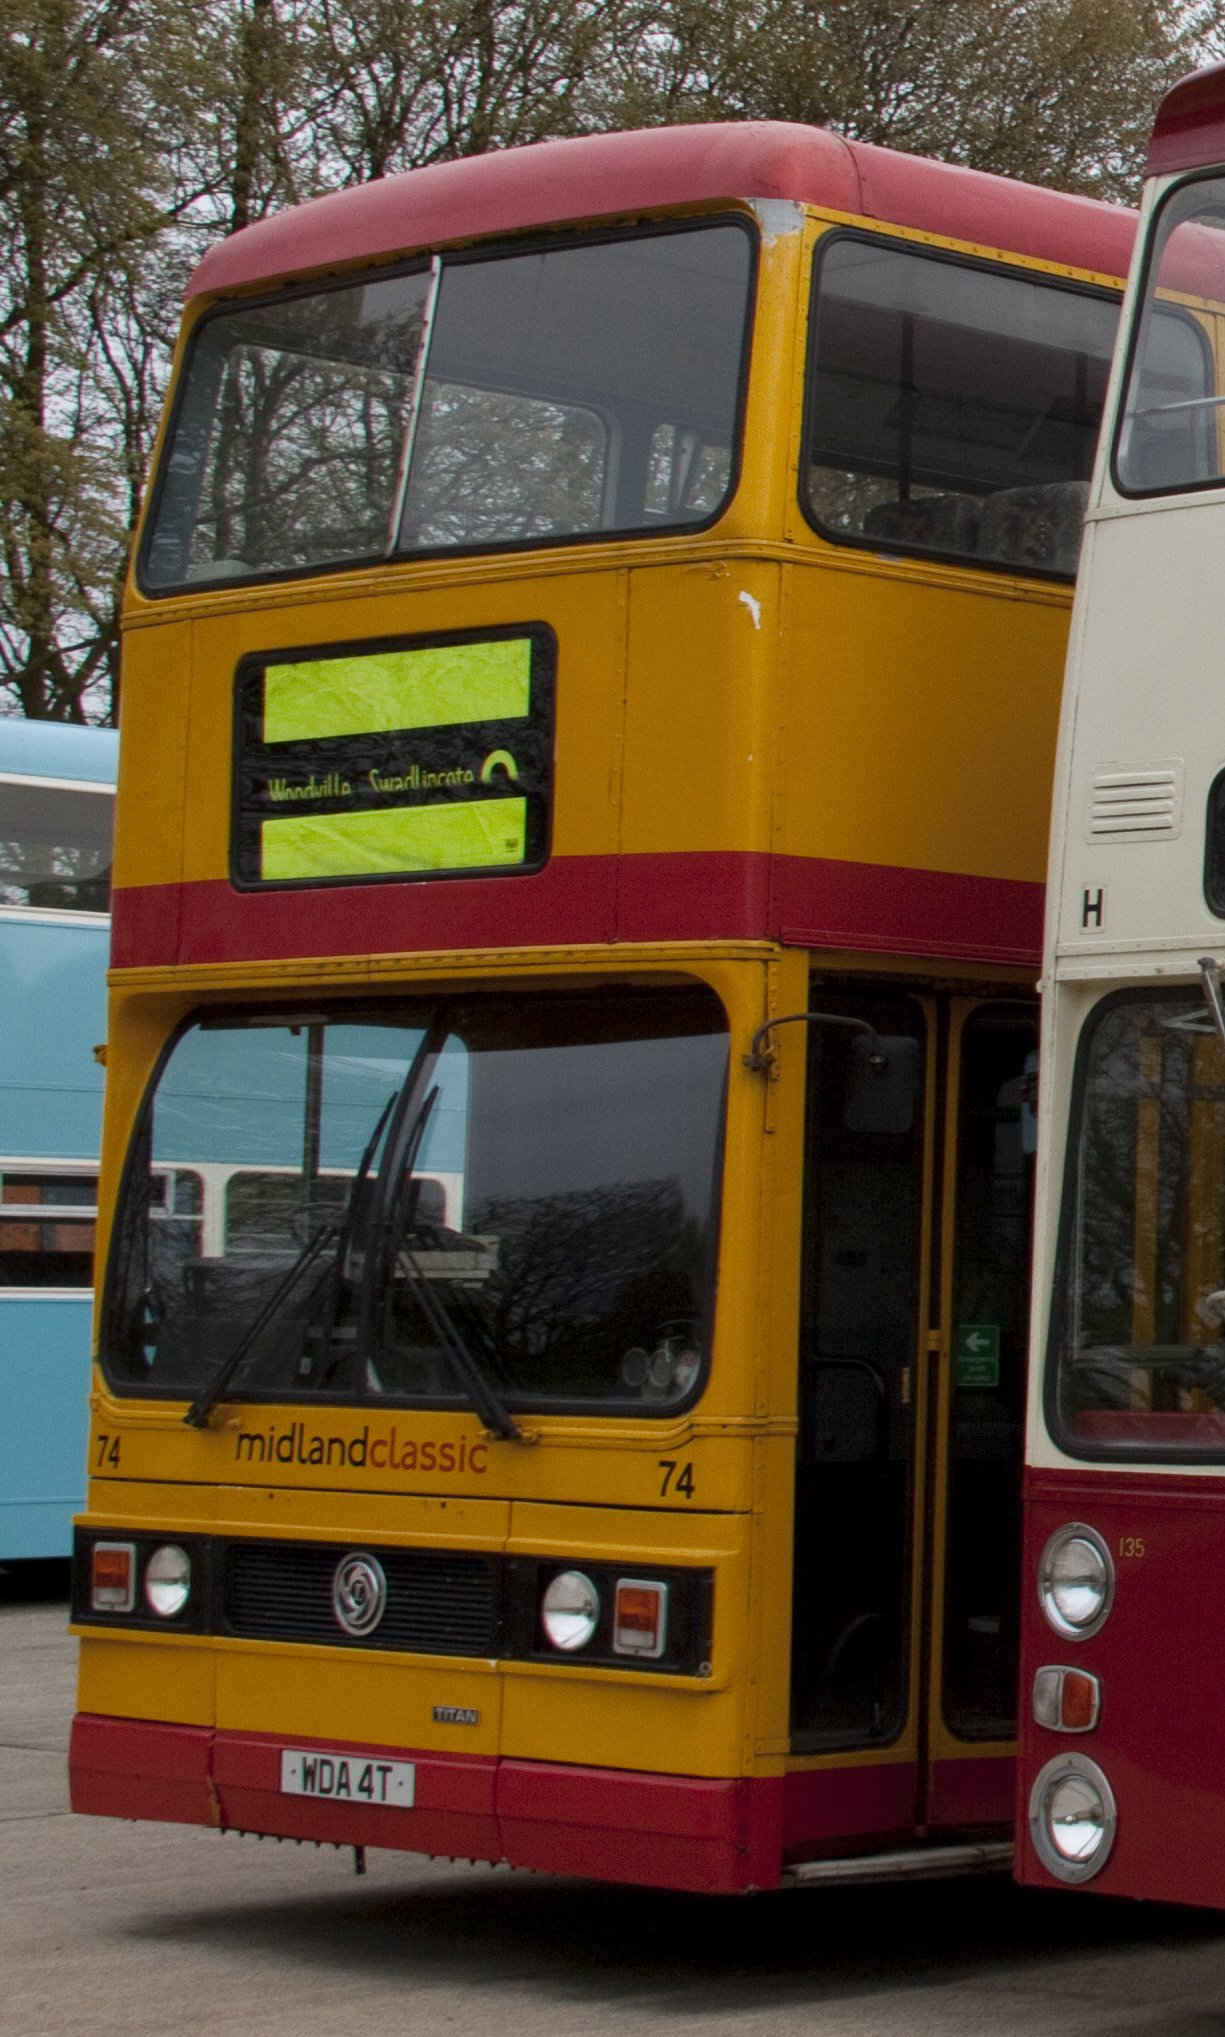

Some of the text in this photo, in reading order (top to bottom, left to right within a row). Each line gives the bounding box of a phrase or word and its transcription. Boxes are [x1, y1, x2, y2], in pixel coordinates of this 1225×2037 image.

[1082, 888, 1104, 928] H
[96, 1435, 121, 1469] 74
[236, 1422, 489, 1475] midlandclassic
[658, 1460, 695, 1499] 74
[1119, 1537, 1145, 1558] 135
[434, 1706, 478, 1725] TITAN
[302, 1756, 393, 1801] WDA 4T
